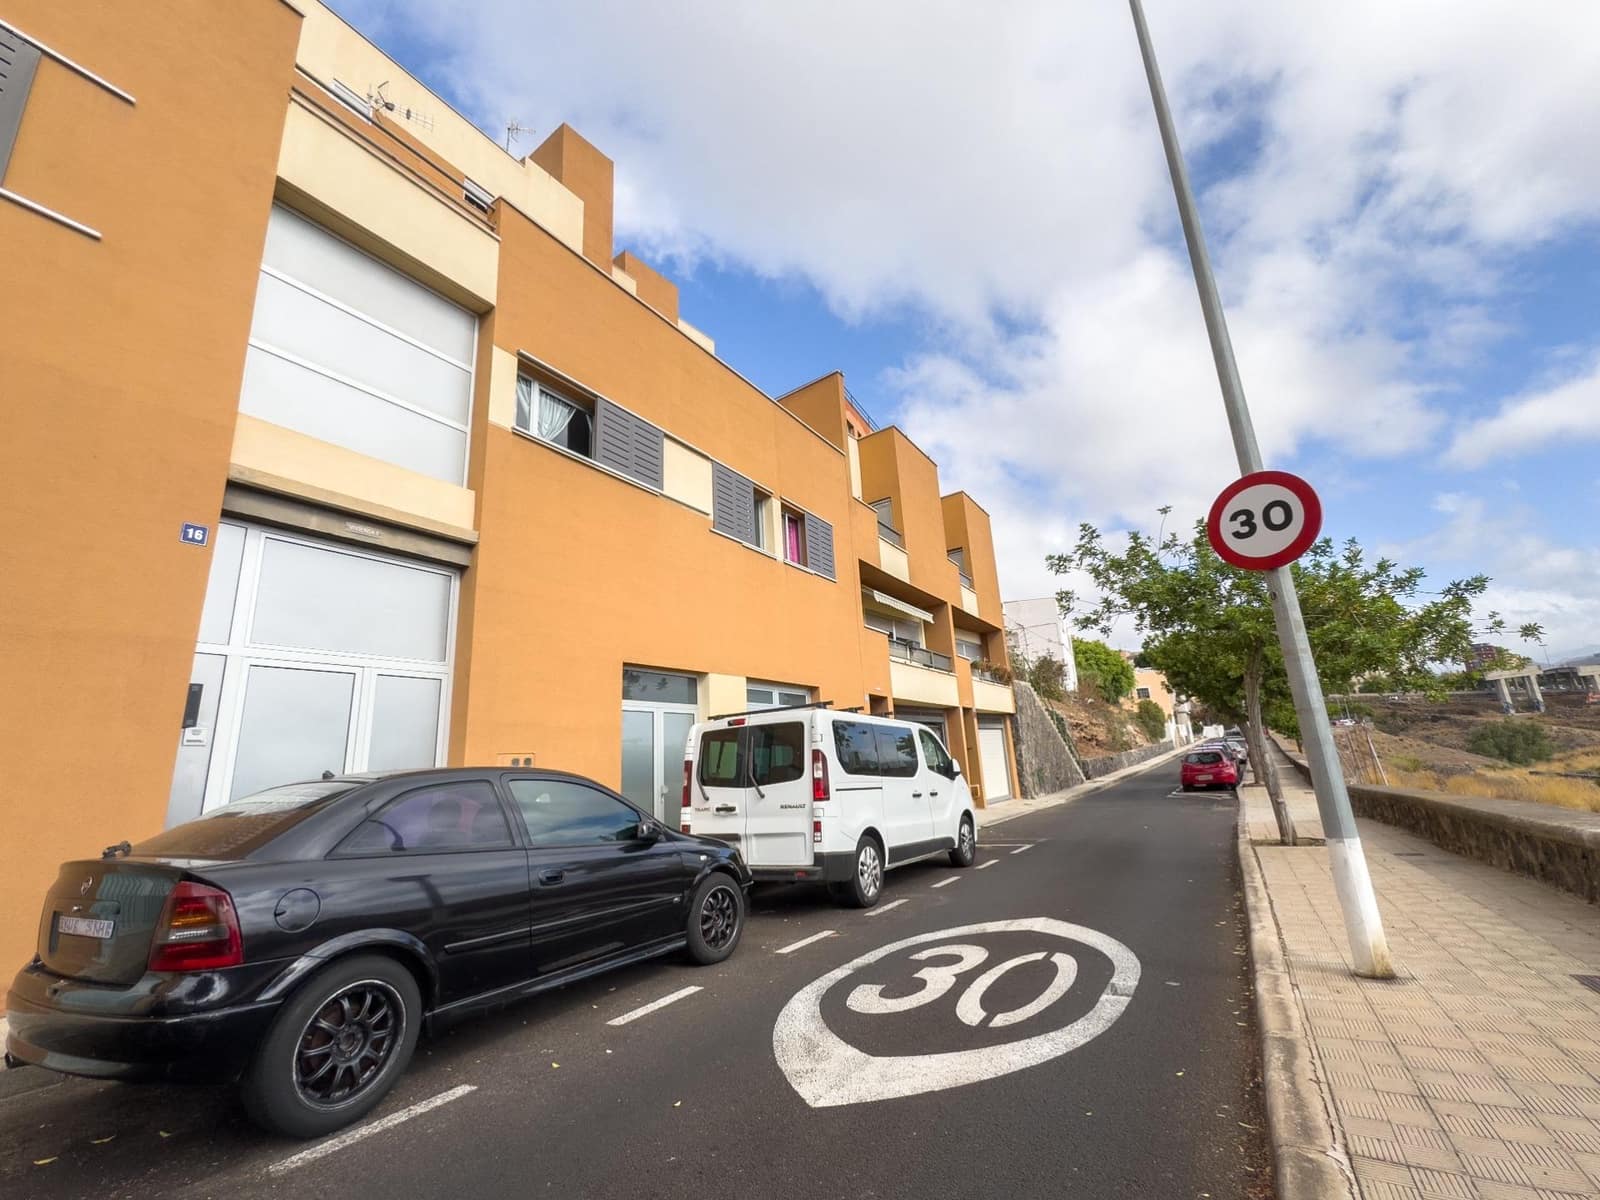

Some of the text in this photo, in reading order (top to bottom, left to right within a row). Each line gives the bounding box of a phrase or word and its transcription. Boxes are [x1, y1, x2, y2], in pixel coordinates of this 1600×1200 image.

[186, 527, 204, 541] 16
[1229, 499, 1293, 539] 30
[846, 944, 1078, 1028] 30
